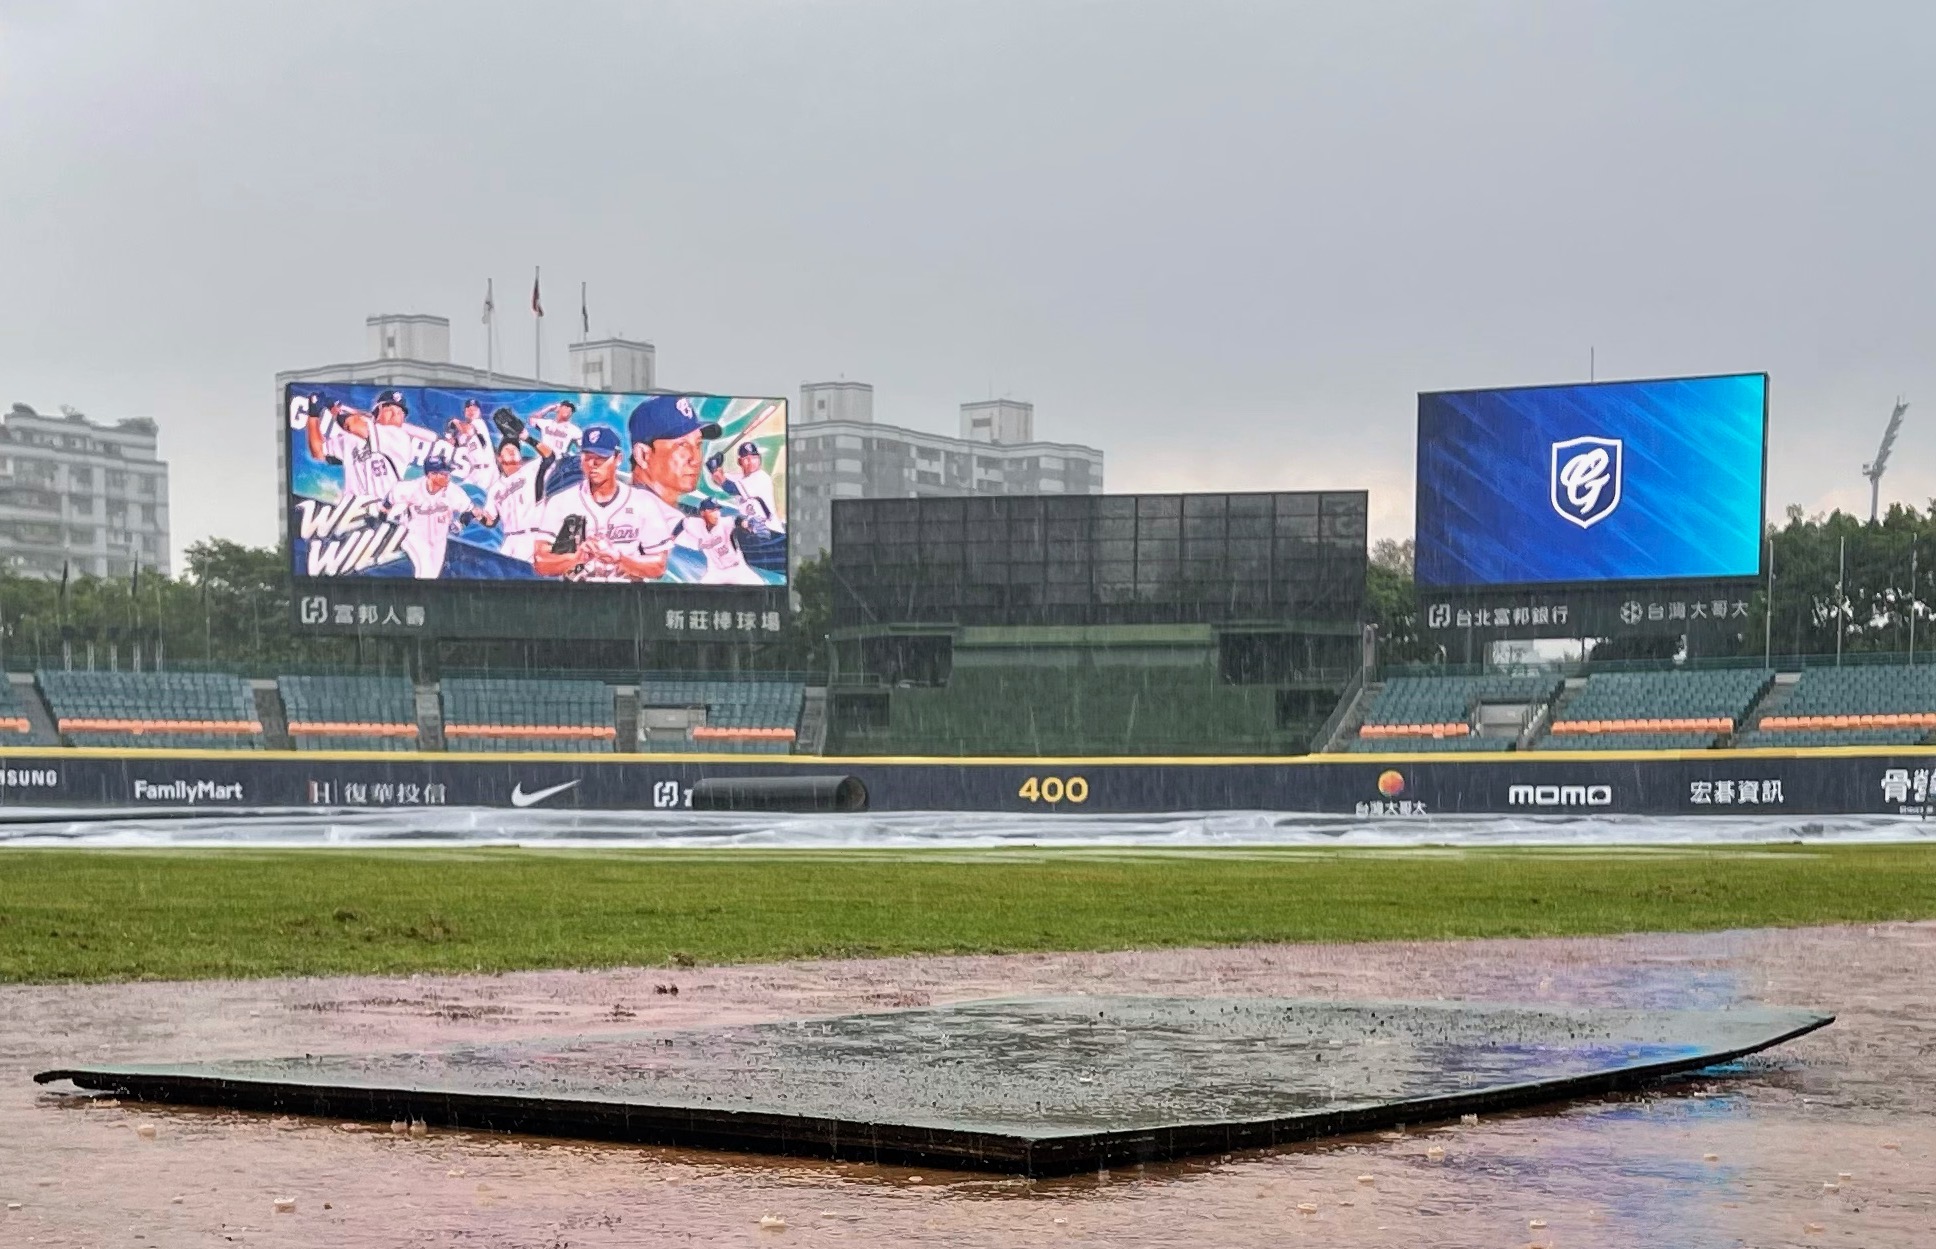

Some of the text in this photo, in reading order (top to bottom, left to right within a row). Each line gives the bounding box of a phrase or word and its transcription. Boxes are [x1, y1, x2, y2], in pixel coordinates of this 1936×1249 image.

[308, 523, 407, 577] WILL
[334, 604, 425, 626] 富邦人壽
[665, 609, 780, 632] 新莊棒球場
[1456, 605, 1568, 627] 台北富邦銀行
[1648, 600, 1749, 621] 台灣大哥大
[134, 780, 243, 805] FamilyMart
[1018, 776, 1089, 803] 400
[1508, 784, 1612, 806] momo
[1690, 780, 1784, 805] 宏碁資訊
